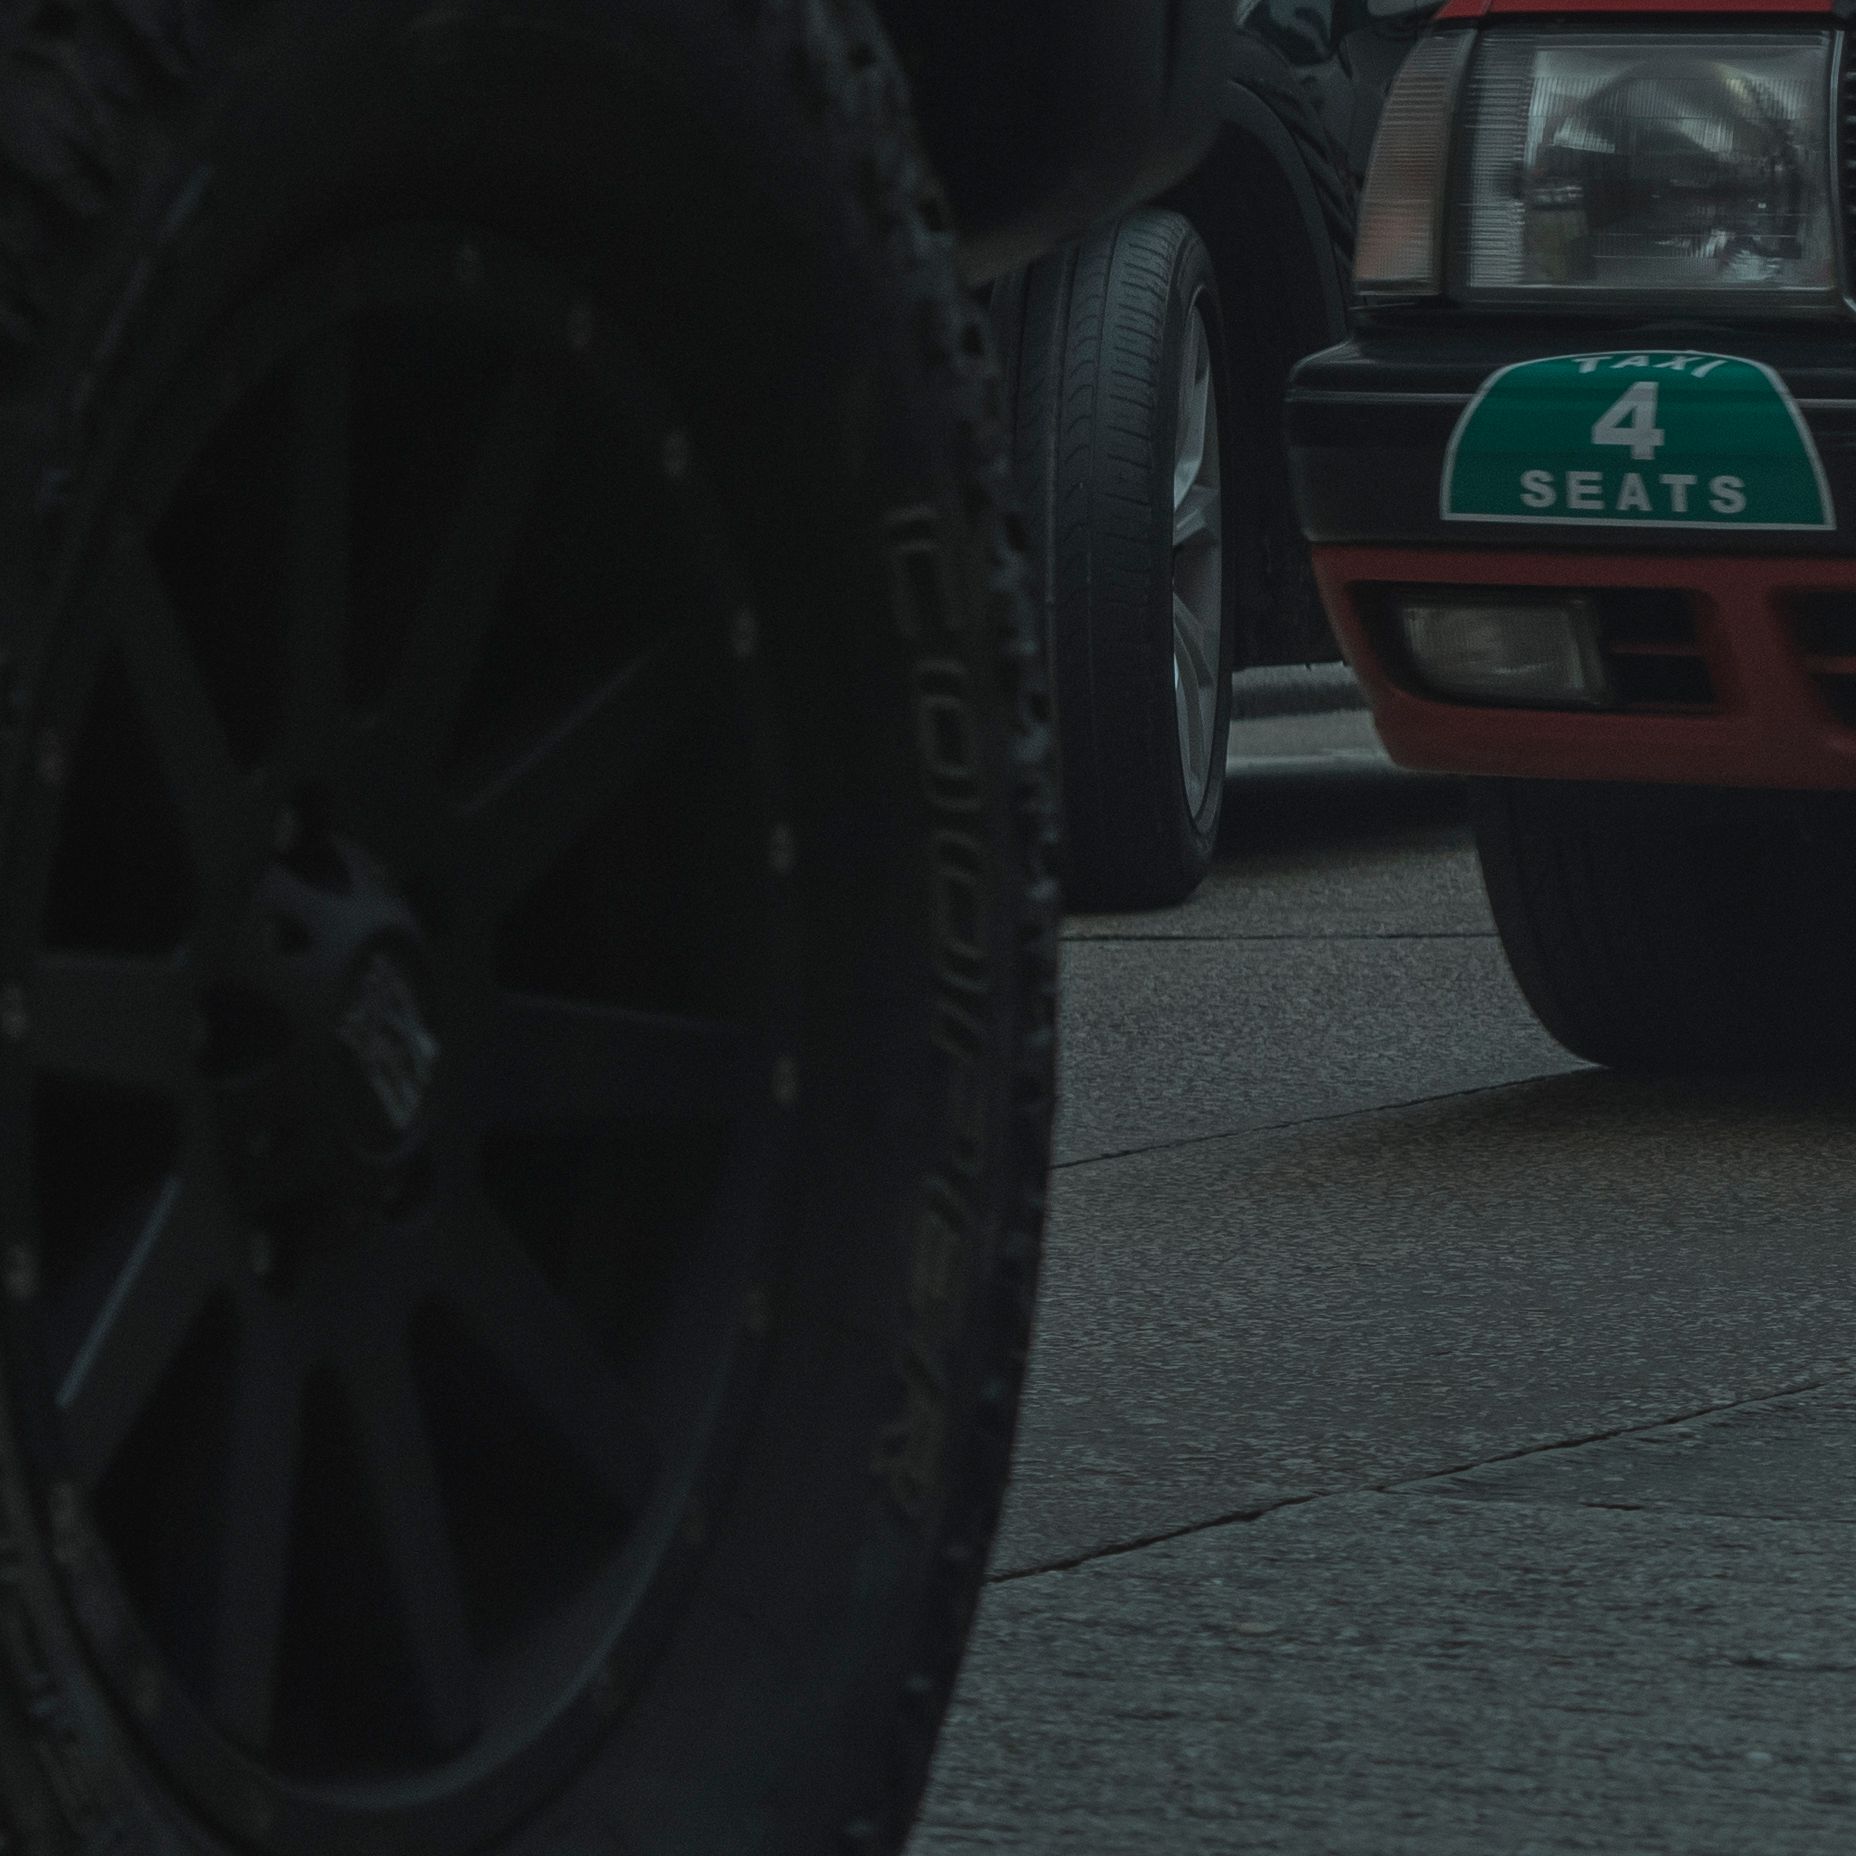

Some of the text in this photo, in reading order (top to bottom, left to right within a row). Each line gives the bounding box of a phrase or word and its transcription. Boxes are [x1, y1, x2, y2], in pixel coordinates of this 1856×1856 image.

[1571, 354, 1729, 378] TAXI
[1590, 380, 1666, 461] 4
[1519, 468, 1748, 515] SEATS
